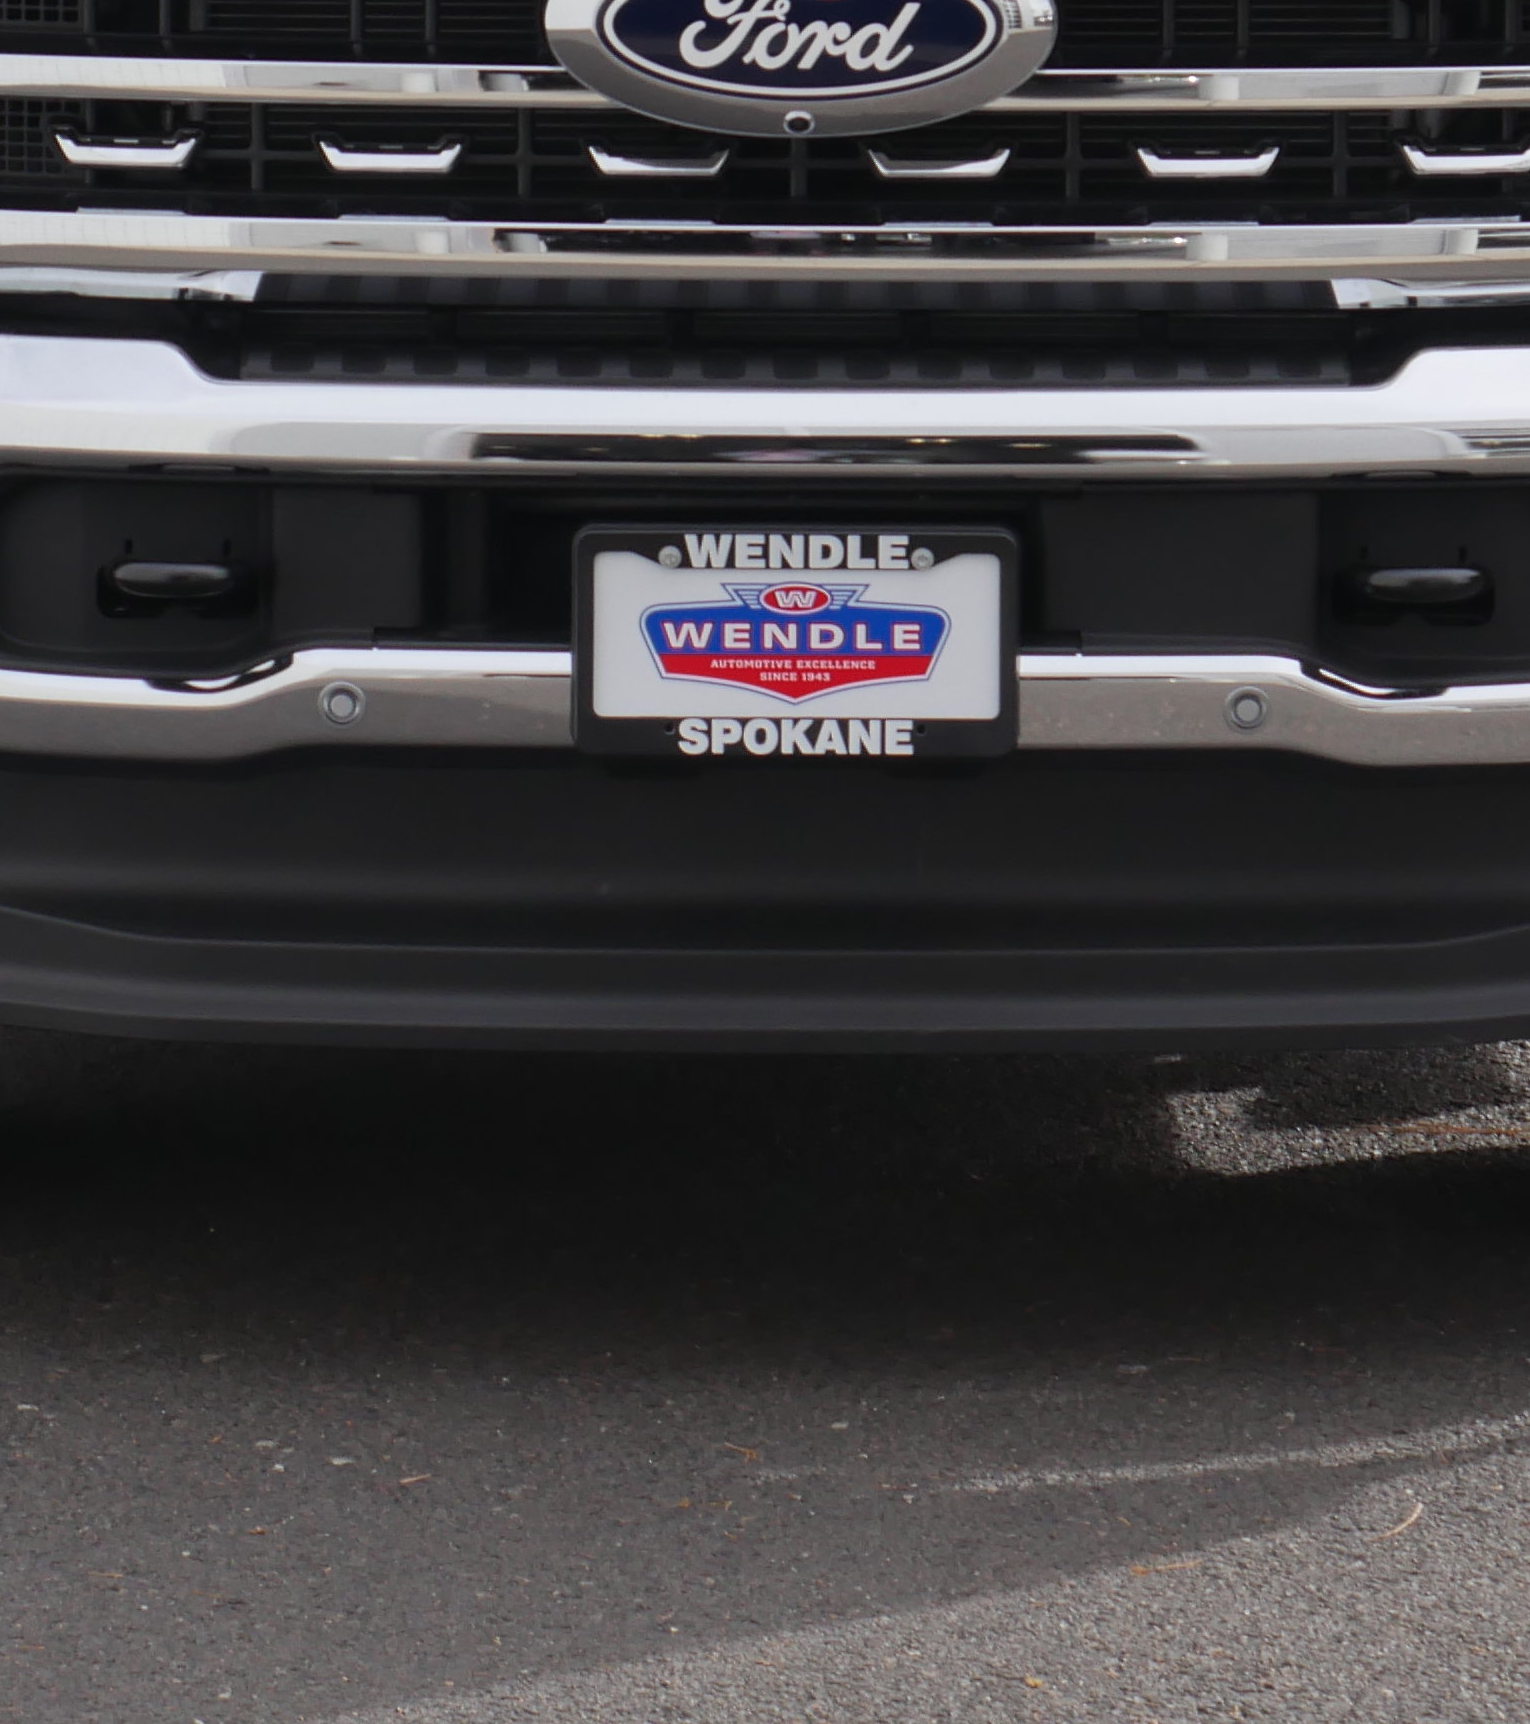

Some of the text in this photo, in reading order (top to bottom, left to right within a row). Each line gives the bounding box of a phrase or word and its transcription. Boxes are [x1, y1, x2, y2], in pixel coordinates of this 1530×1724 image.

[684, 534, 910, 570] WENDLE
[663, 622, 923, 650] WENDLE
[710, 659, 876, 670] AUTOMOTIVE EXCELLENCE
[759, 671, 798, 682] SINCE
[678, 718, 914, 756] SPOKANE
